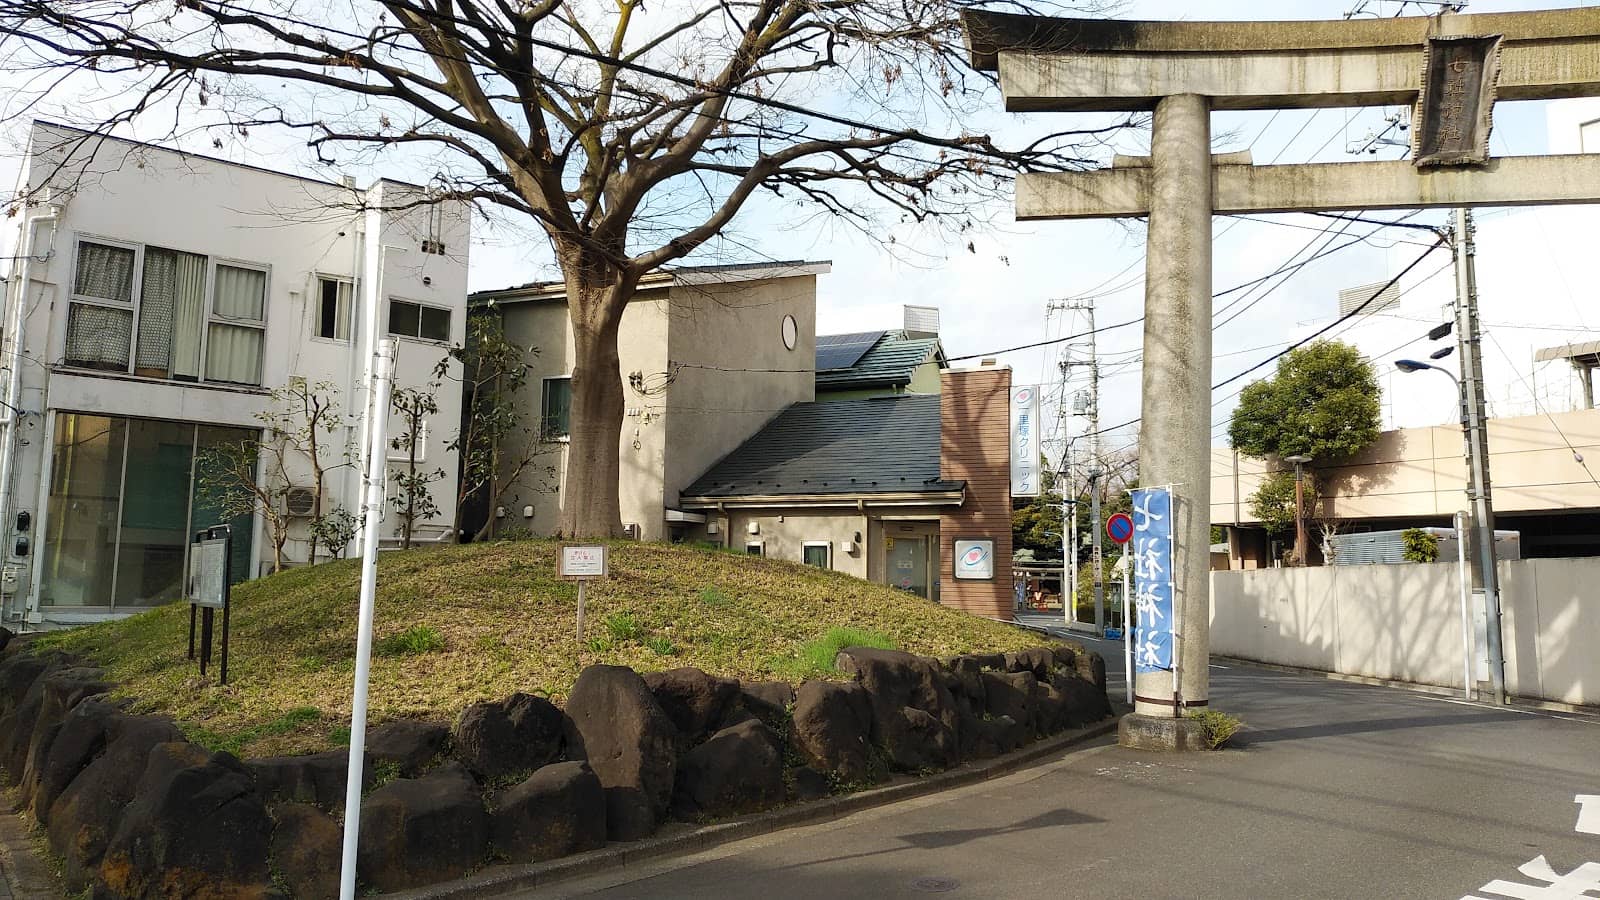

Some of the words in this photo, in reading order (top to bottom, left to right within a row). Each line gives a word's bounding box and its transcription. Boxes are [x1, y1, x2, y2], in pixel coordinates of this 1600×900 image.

[1018, 406, 1030, 492] 一里塚クリニック
